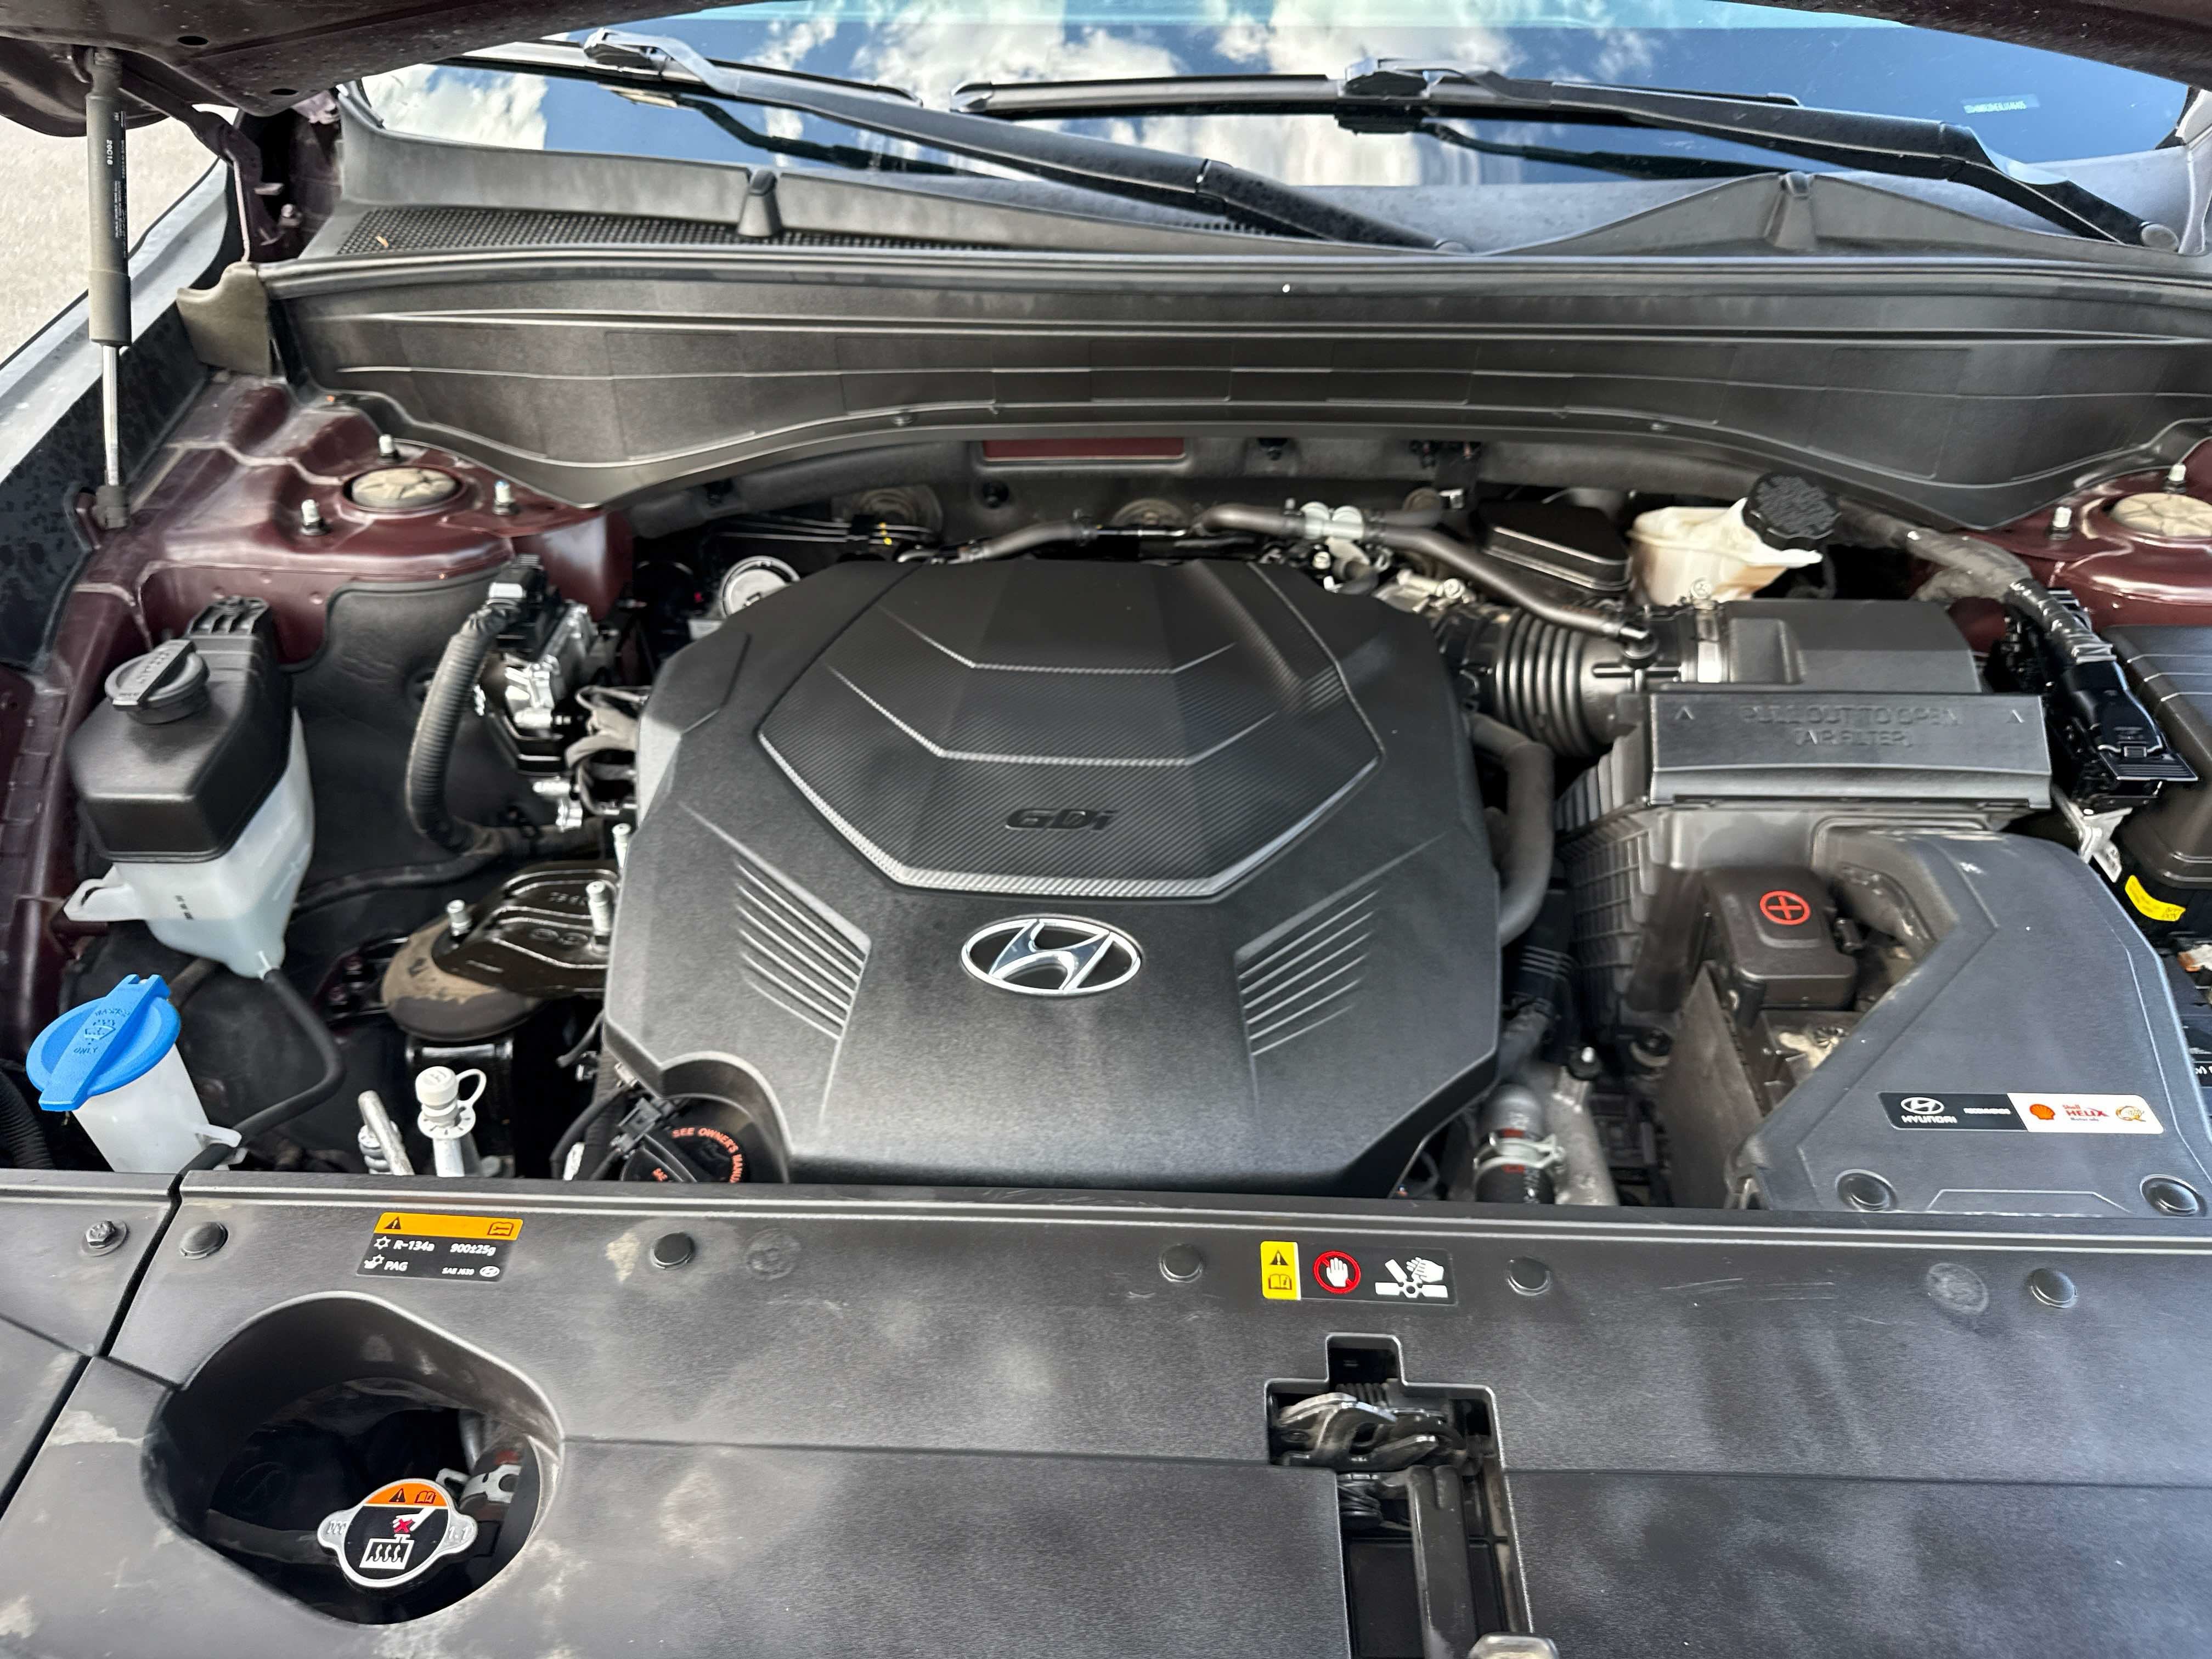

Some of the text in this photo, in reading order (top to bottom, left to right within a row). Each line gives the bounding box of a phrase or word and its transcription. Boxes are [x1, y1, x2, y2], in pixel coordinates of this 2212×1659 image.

[2065, 1108, 2110, 1118] HELIX
[1901, 1115, 1957, 1124] HYUNDAI
[672, 1127, 695, 1138] SEE
[729, 1154, 743, 1183] MANU
[393, 1239, 496, 1256] R-134a 900±25g
[383, 1261, 408, 1271] PAG
